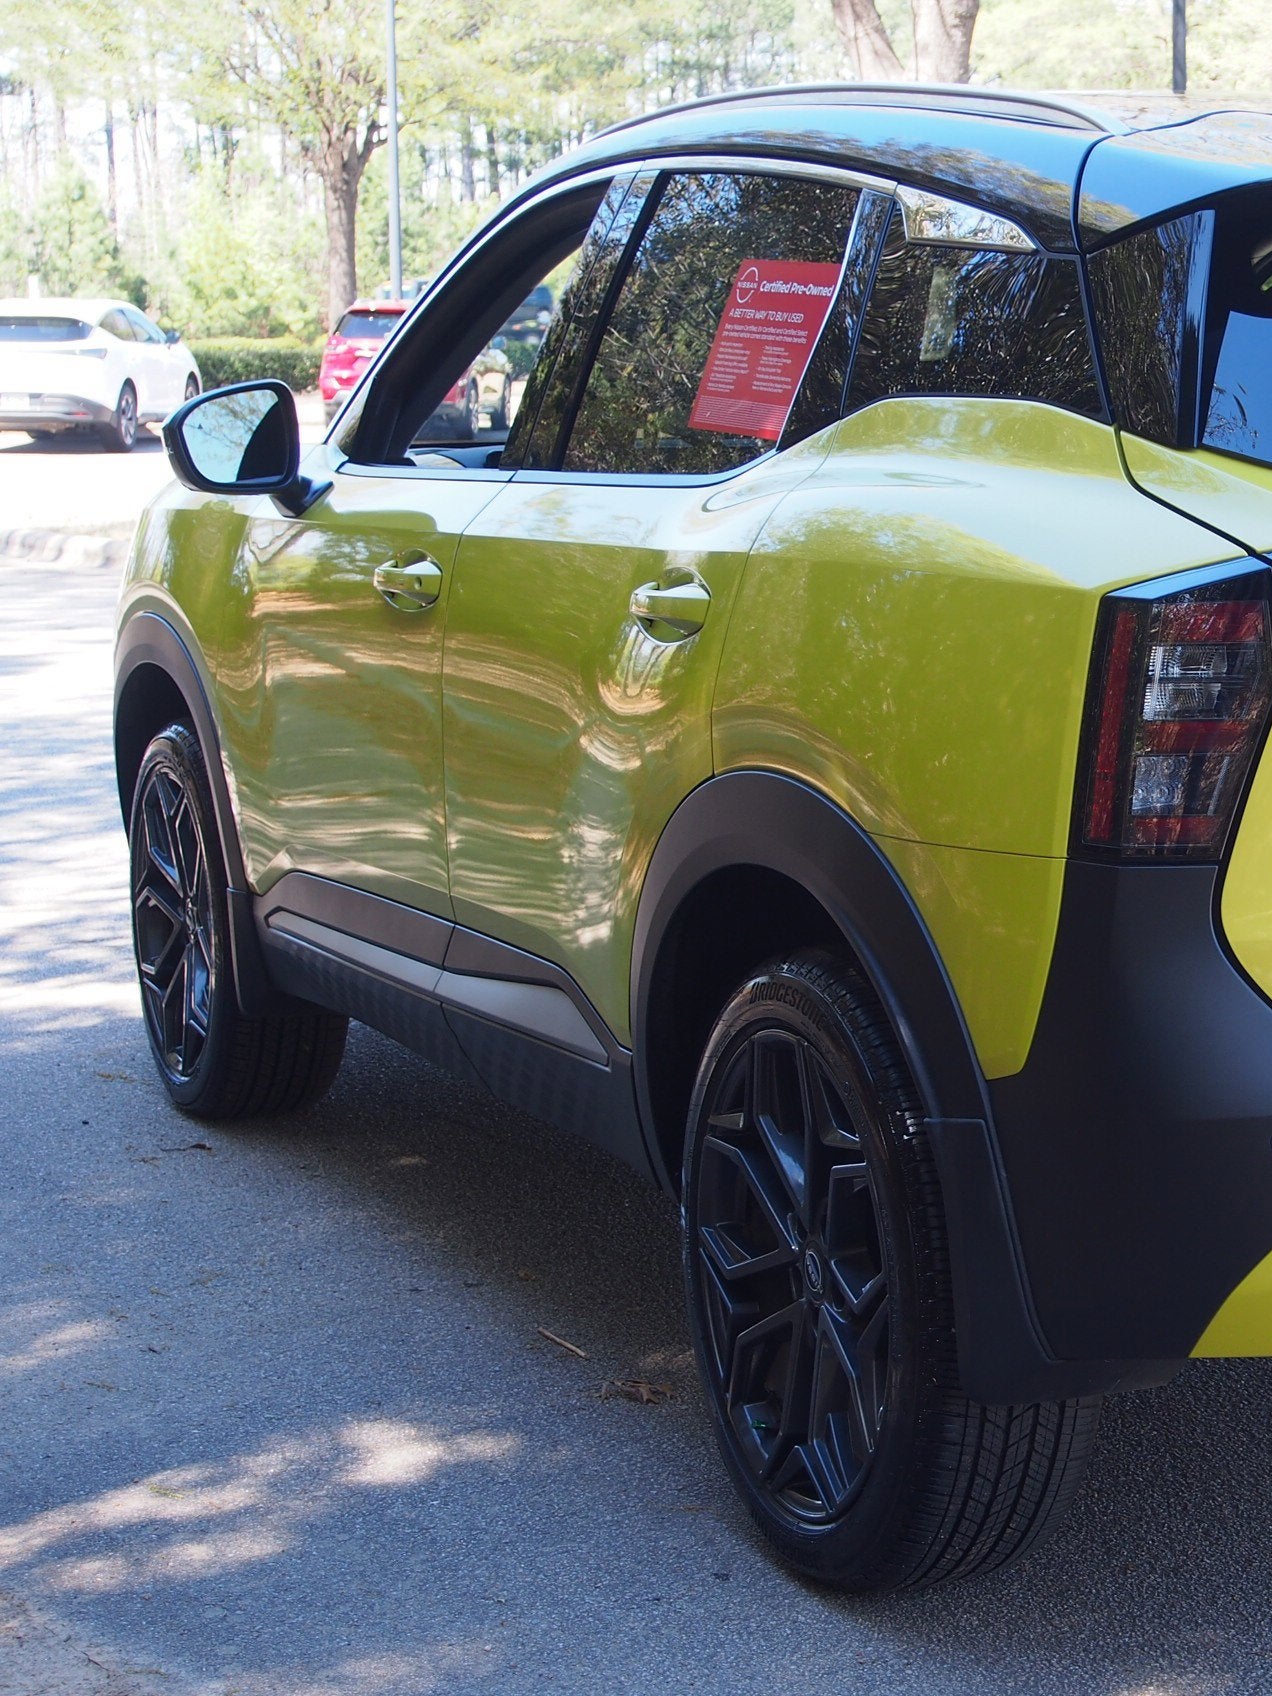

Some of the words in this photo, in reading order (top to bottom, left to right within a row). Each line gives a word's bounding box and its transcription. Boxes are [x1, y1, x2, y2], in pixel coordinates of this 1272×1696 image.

[760, 280, 792, 294] Certified
[789, 282, 835, 297] Pre-Owned
[728, 308, 735, 317] A
[734, 308, 755, 319] BETTER
[755, 309, 767, 320] WAY
[766, 310, 776, 321] TO
[775, 311, 788, 322] BUY
[788, 312, 804, 323] USED
[750, 981, 828, 1032] BRIDGESTONE
